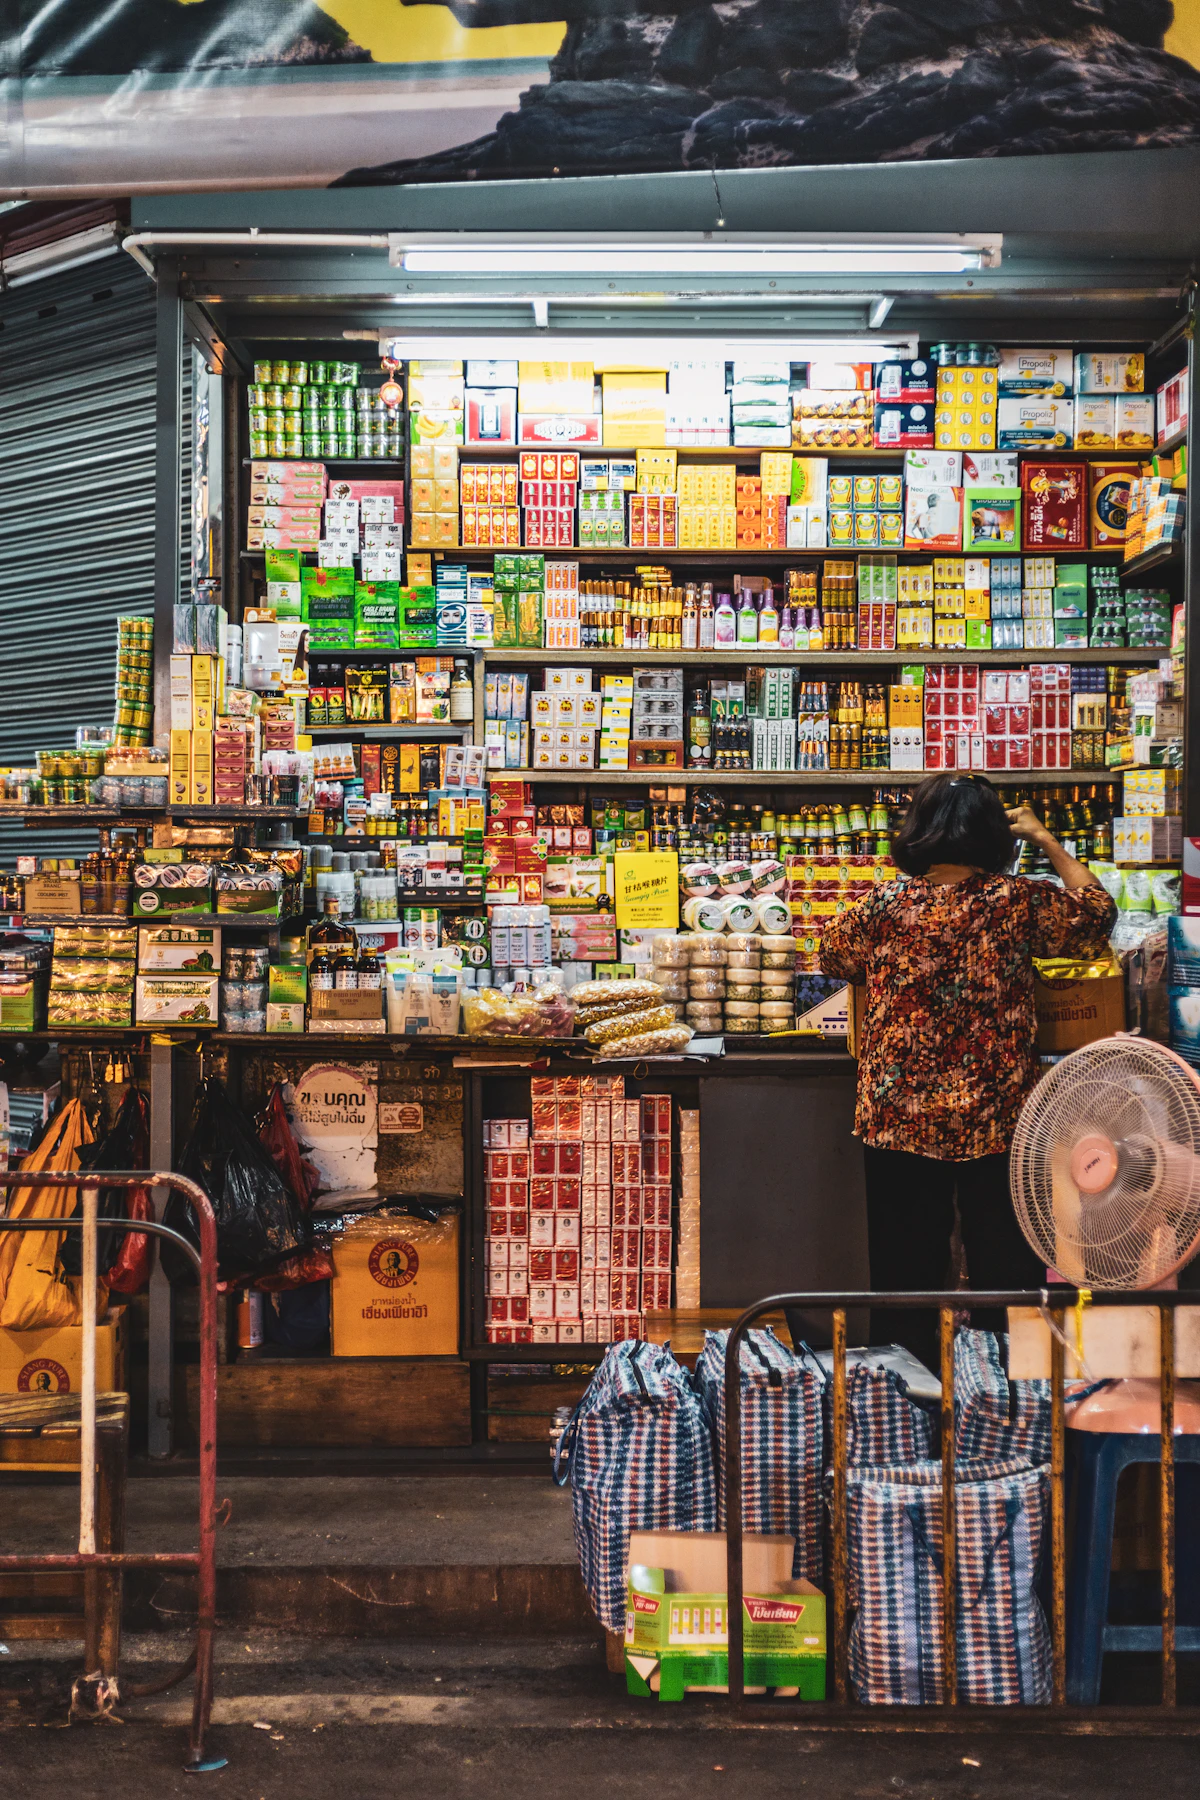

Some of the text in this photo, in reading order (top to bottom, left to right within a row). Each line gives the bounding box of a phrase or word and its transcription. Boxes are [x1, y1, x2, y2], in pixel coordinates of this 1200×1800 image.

[1022, 360, 1052, 368] Propoliz
[424, 1065, 440, 1078] รัก
[372, 1242, 396, 1259] SIANG
[372, 1293, 416, 1305] ยาหม่องน้ำ
[20, 1361, 67, 1378] SIANG PURE
[636, 1601, 656, 1610] POY-SIAN
[752, 1606, 798, 1619] โป๊ยเซียน
